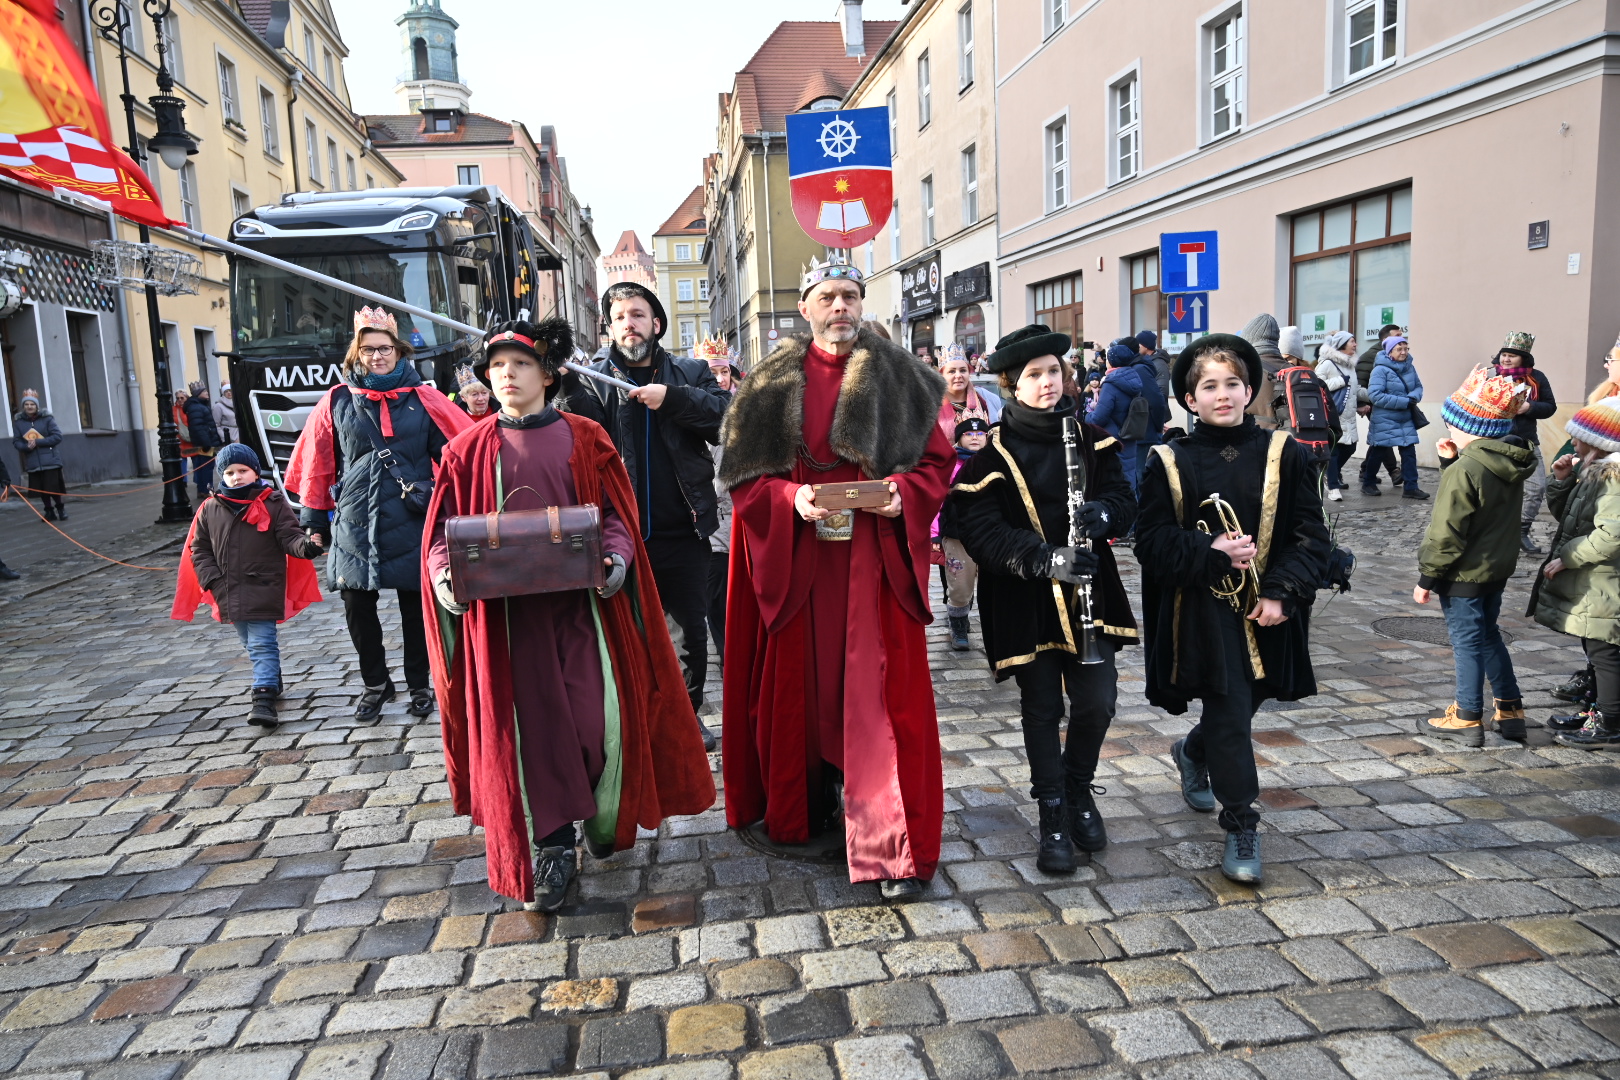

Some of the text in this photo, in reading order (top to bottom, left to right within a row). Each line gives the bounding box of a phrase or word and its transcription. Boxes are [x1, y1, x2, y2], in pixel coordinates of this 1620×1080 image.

[1535, 226, 1541, 235] 8
[271, 415, 280, 426] L
[1309, 413, 1315, 421] 2
